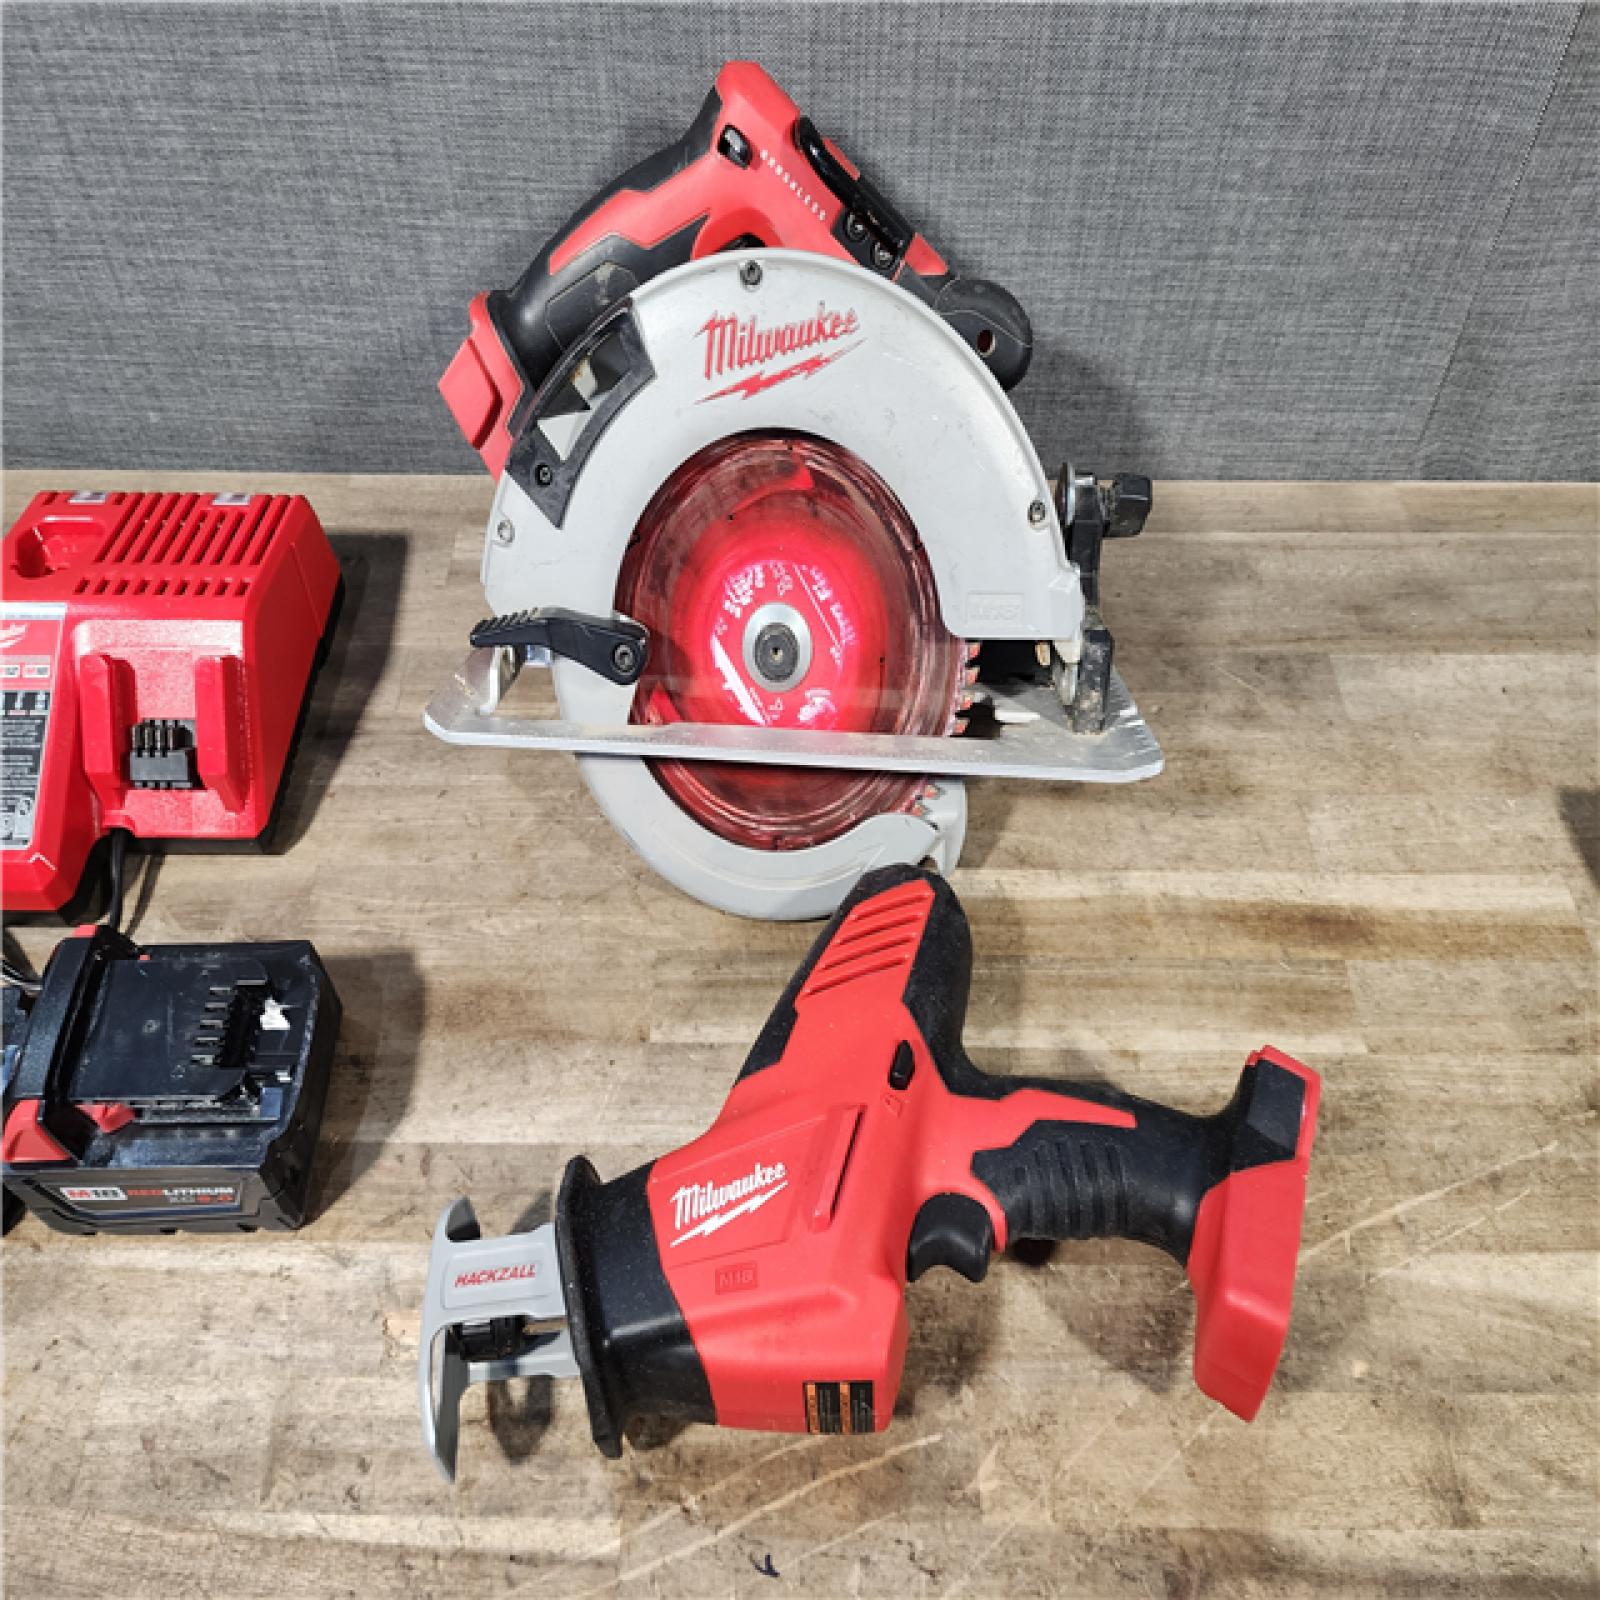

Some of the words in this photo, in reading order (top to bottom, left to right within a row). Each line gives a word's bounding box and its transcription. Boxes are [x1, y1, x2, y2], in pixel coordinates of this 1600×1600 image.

[691, 300, 860, 381] Milwaukee
[670, 1162, 787, 1230] Milwaukee
[454, 1264, 536, 1288] HACKZALL
